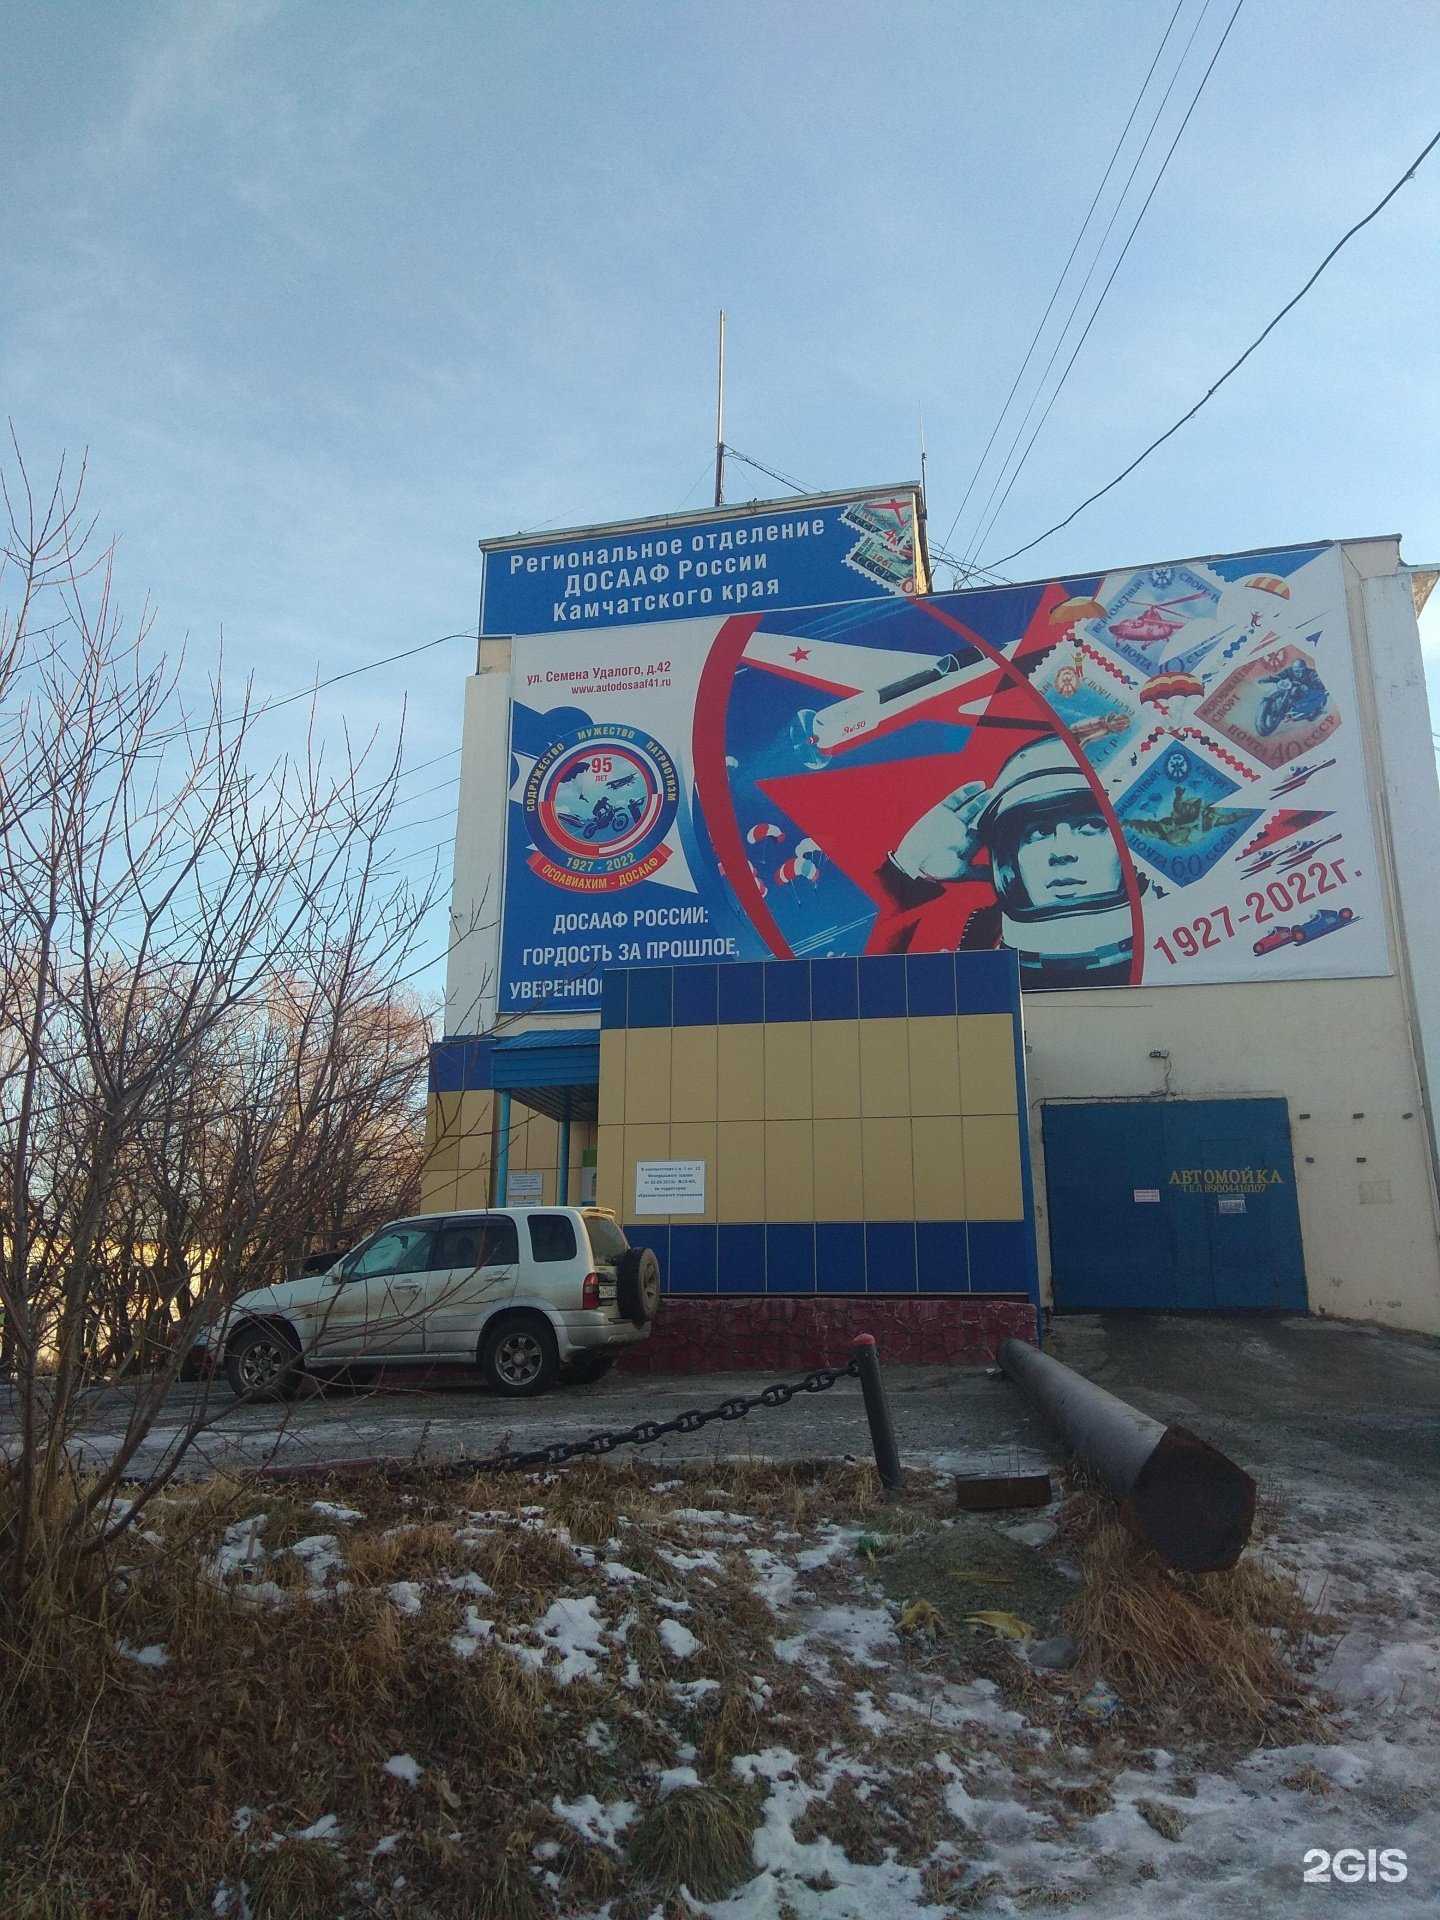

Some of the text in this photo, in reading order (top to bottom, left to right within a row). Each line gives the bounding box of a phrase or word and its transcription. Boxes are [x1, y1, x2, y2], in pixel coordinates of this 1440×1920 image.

[510, 539, 683, 574] Региональное
[691, 517, 825, 553] отделение
[564, 552, 768, 598] ДОСААФ России
[553, 578, 780, 622] Камчатского края
[527, 673, 543, 686] ул.
[545, 668, 590, 683] Семена
[646, 660, 671, 677] д.42
[571, 678, 671, 695] www.autodosaaf41.ru
[527, 726, 676, 812] СОДРУЖЕСТВО МУЖЕСТВО ПАТРИОТИЗМ
[591, 757, 613, 774] 95
[542, 863, 608, 889] ОСОАВИАХИМ
[618, 858, 659, 887] ДОСААФ
[566, 857, 594, 873] 1927
[606, 852, 636, 873] 2022
[1172, 853, 1202, 878] 60
[553, 906, 709, 935] ДОСААФ РОССИИ:
[1153, 858, 1363, 965] 1927-2022г.
[523, 937, 740, 967] ГОРДОСТЬ ЗА ПРОШЛОЕ,
[1168, 1167, 1284, 1185] АВТОМОЙКА
